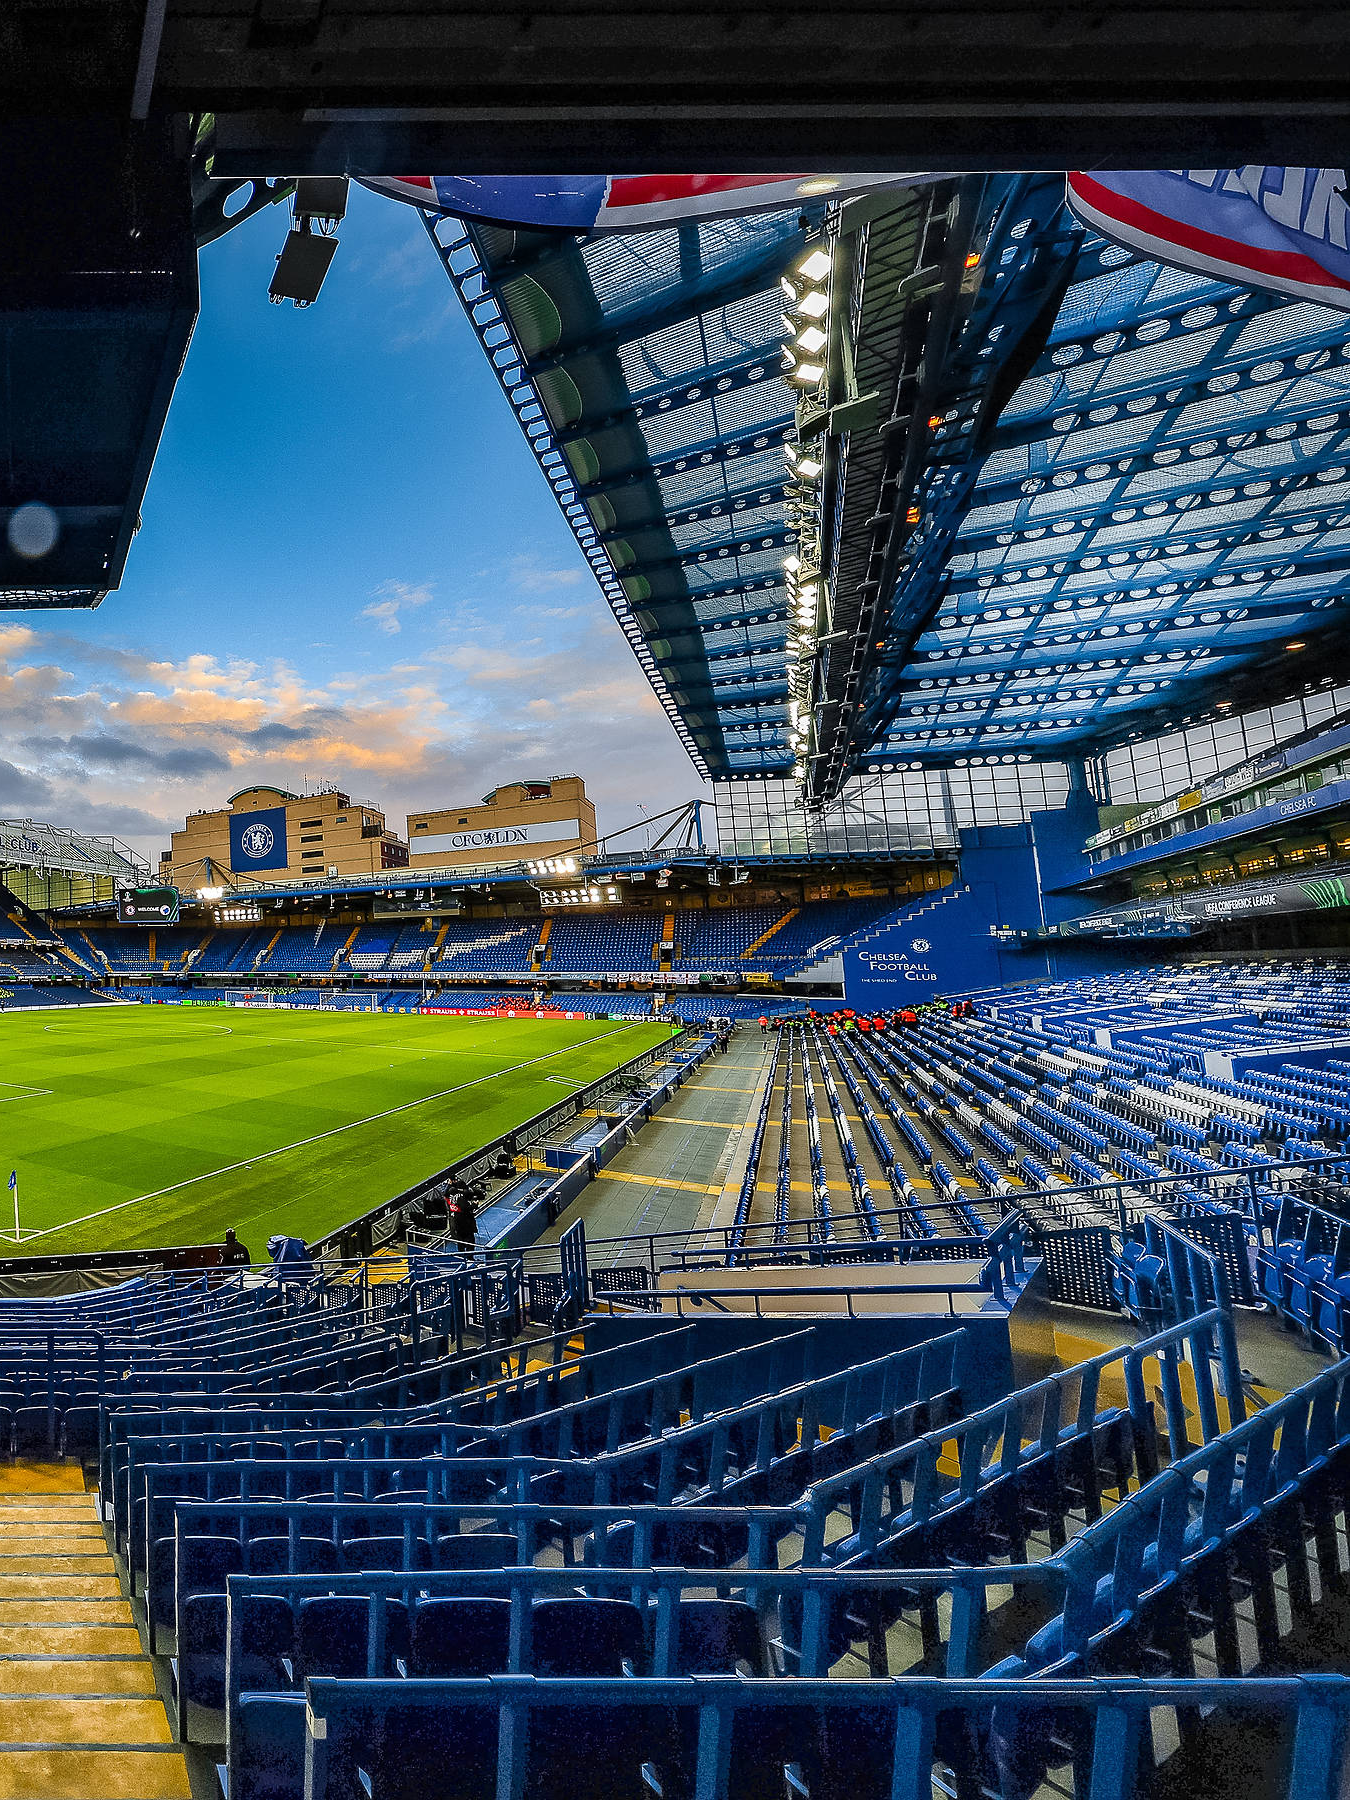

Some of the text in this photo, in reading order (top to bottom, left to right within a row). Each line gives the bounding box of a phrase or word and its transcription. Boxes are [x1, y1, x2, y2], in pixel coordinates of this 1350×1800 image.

[1280, 795, 1317, 816] CHELSEA FC
[10, 837, 39, 852] CLUB
[452, 828, 528, 847] CFC LDN
[1252, 893, 1277, 907] LEAGUE
